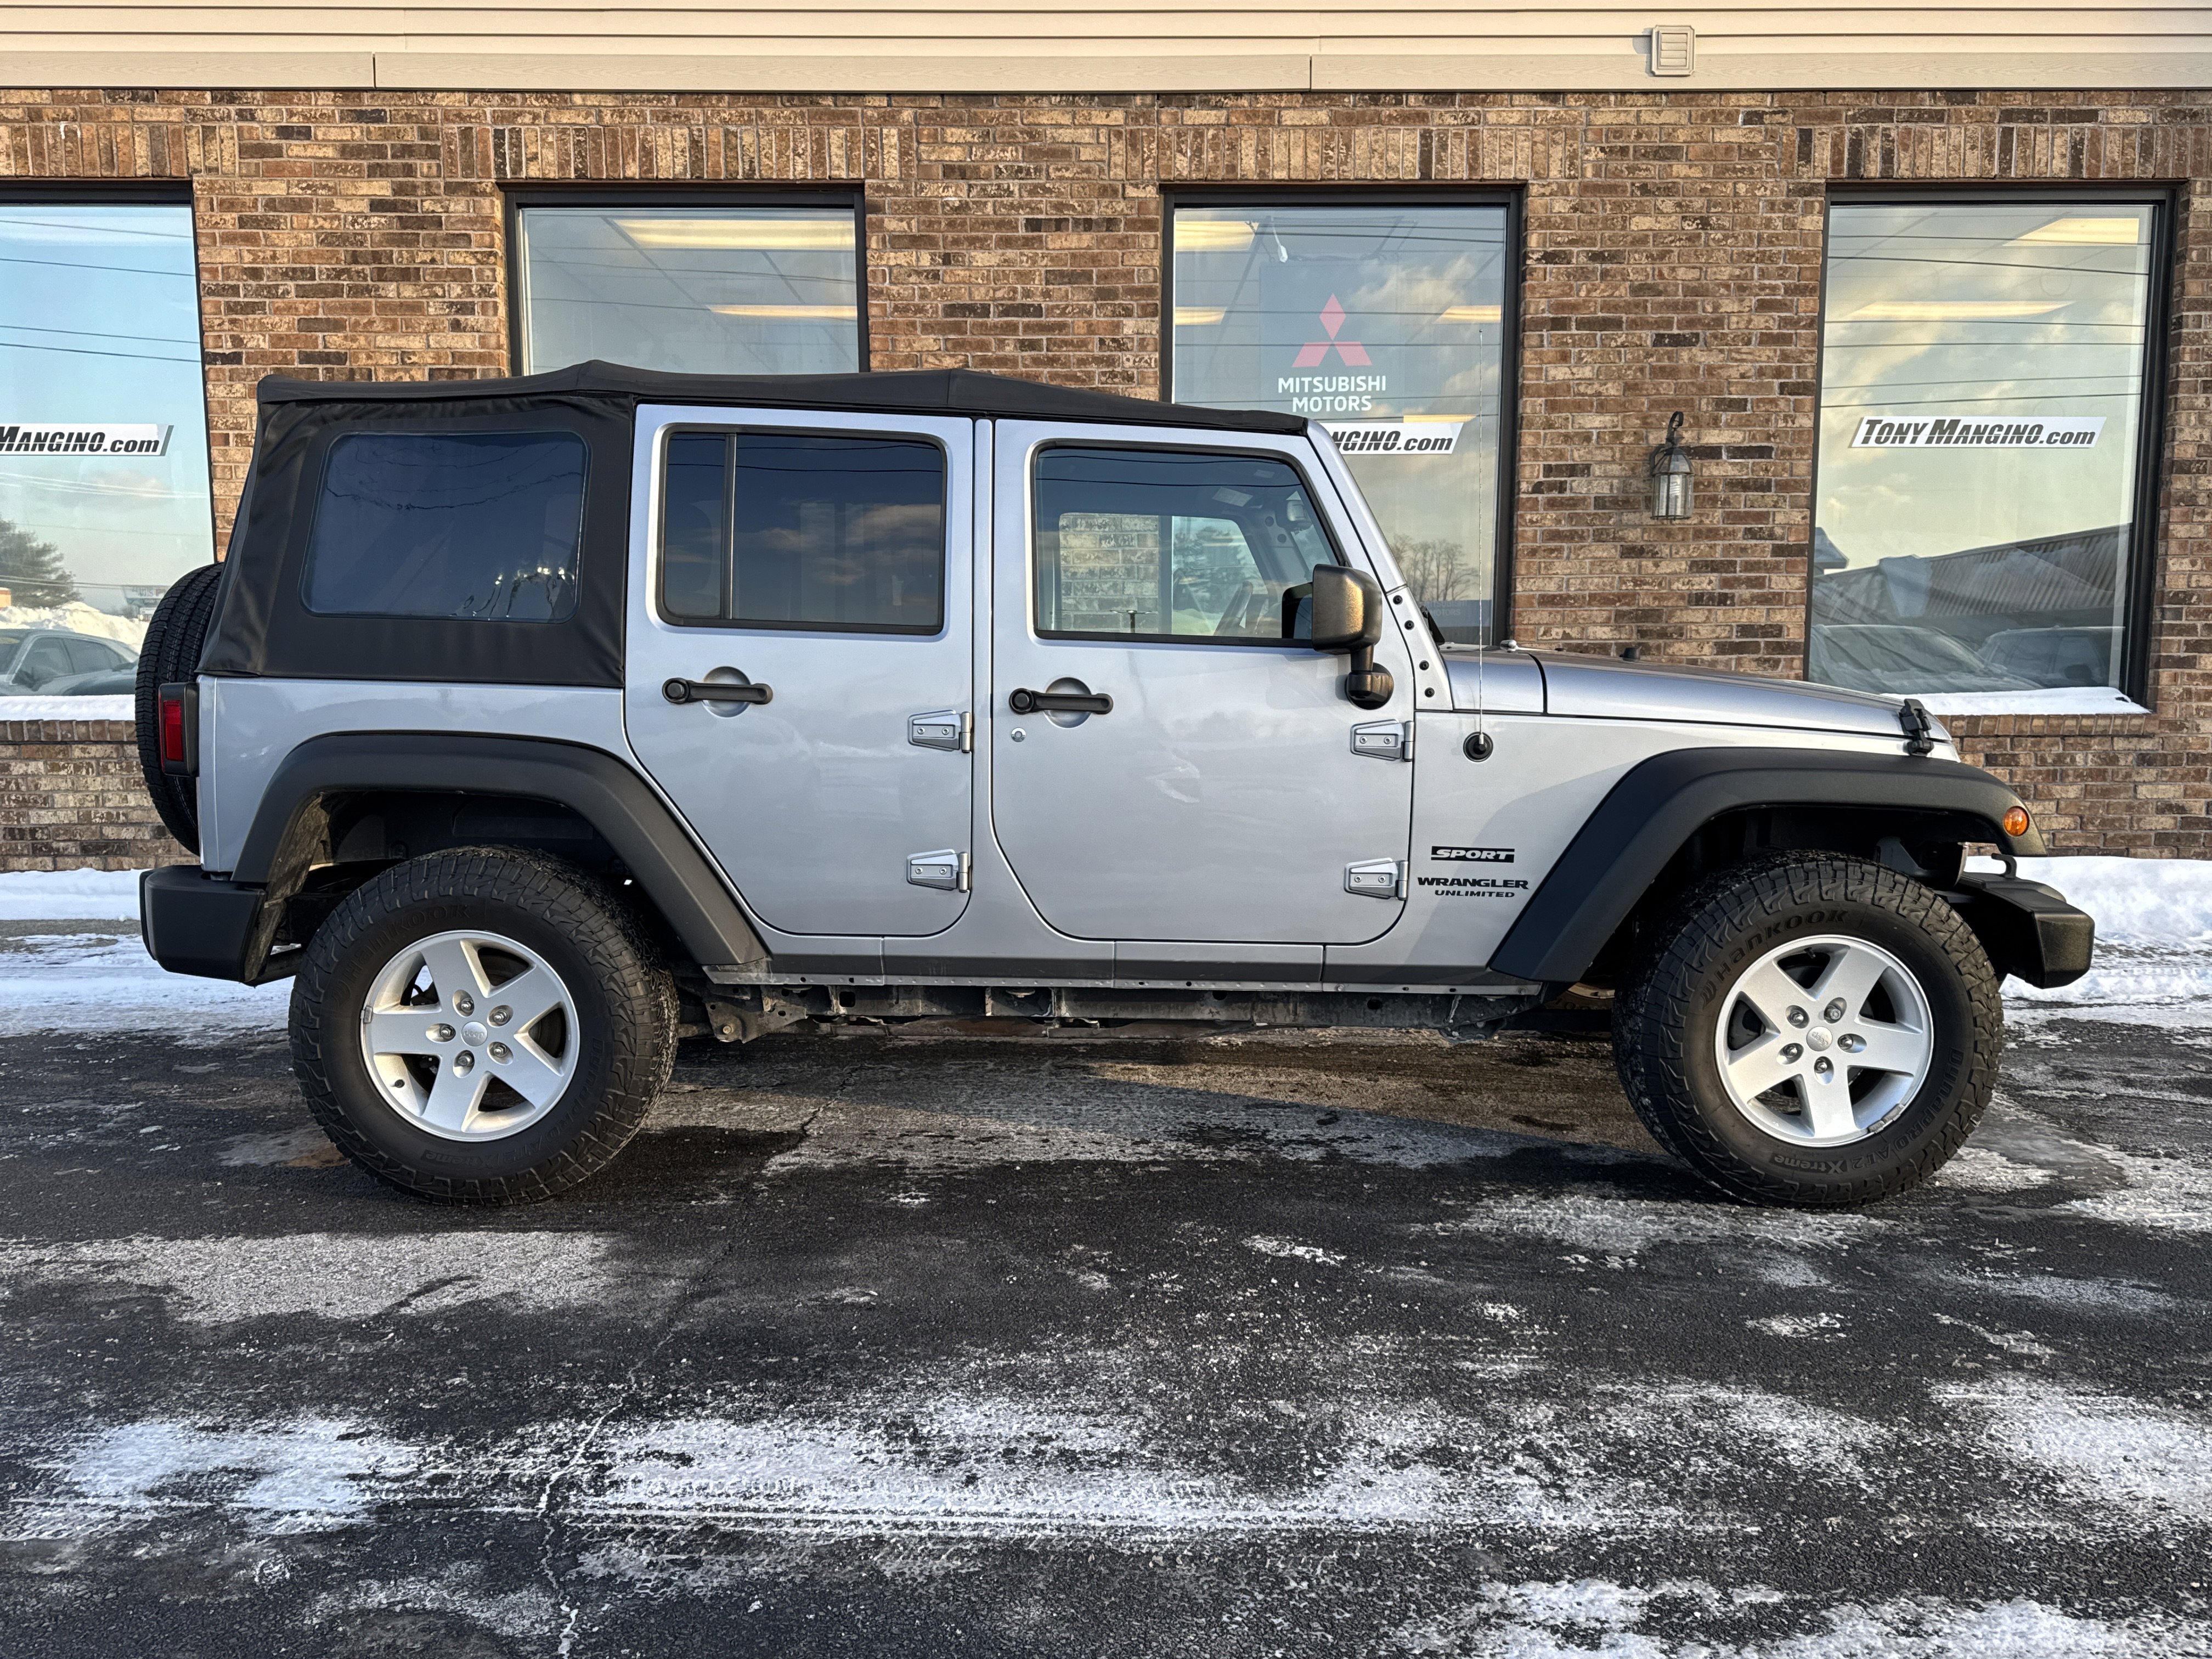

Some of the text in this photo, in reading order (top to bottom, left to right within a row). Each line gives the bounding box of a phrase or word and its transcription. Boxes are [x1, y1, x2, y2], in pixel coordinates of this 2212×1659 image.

[1278, 375, 1386, 393] MITSUBISHI
[1293, 395, 1372, 413] MOTORS
[1331, 430, 1453, 451] NGINO.com
[1431, 848, 1515, 860] SPORT
[1417, 877, 1529, 890] WRANGLER
[1435, 889, 1515, 898] UNLIMITED
